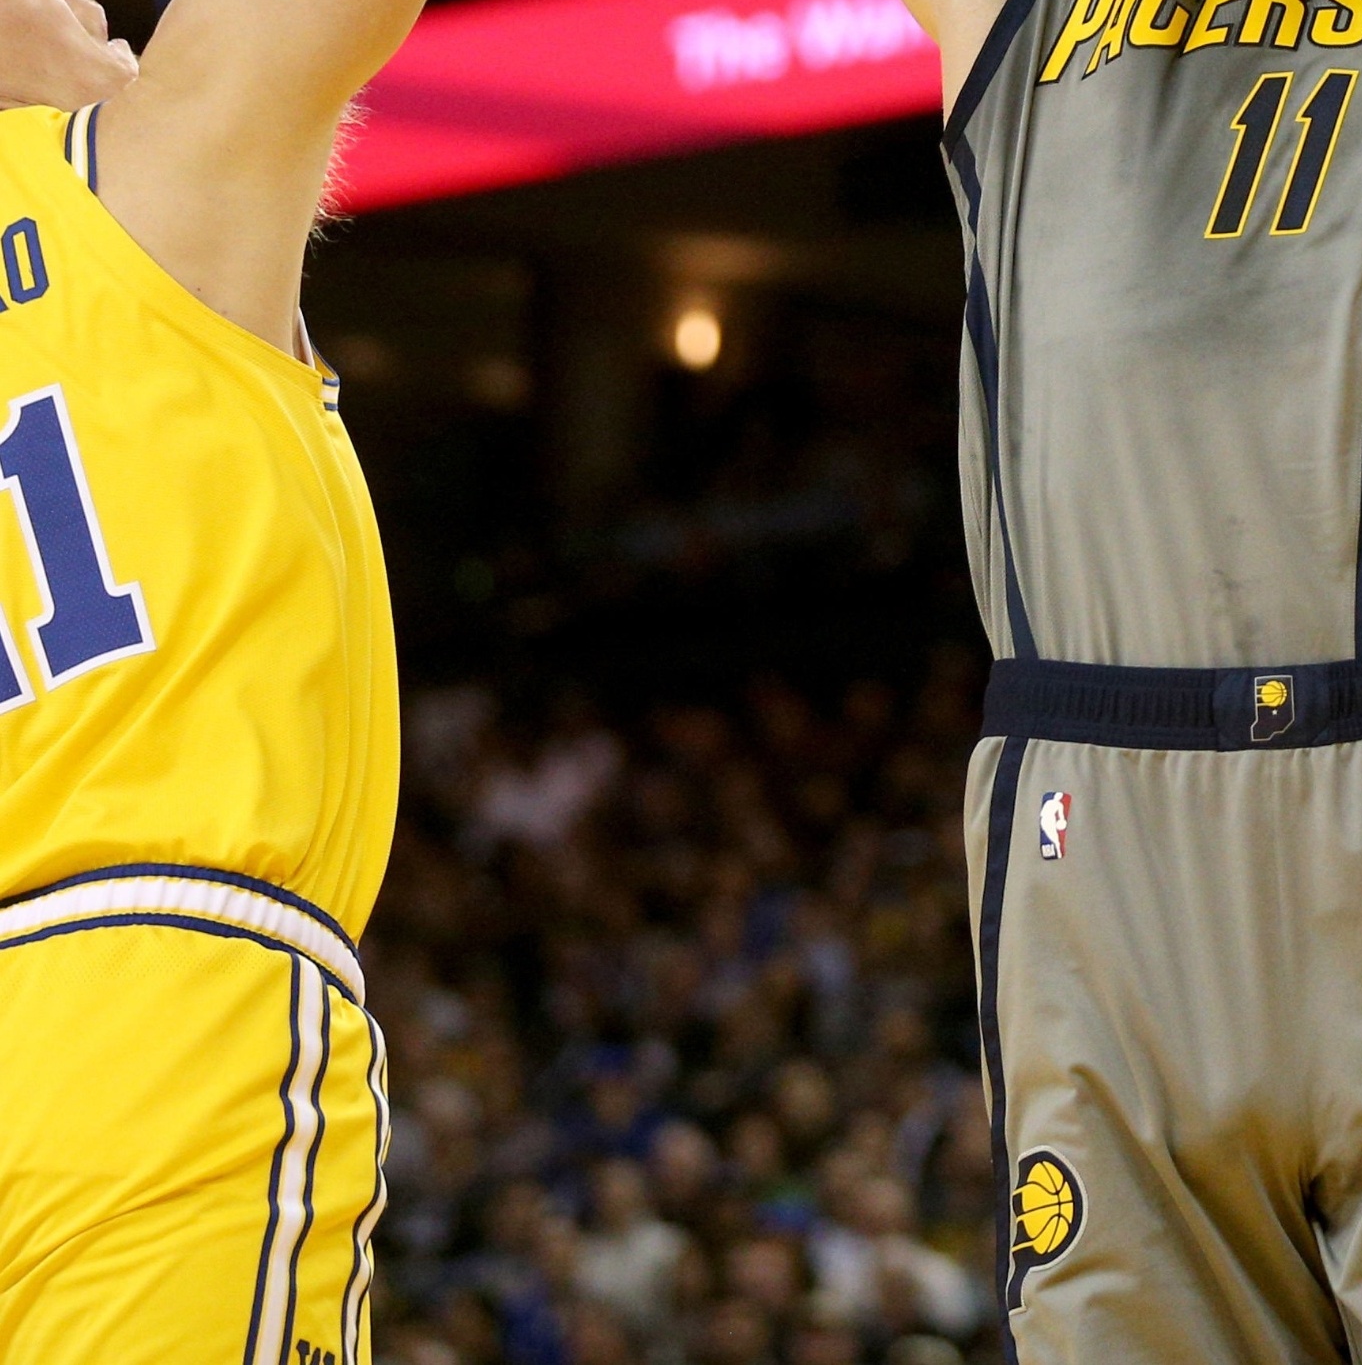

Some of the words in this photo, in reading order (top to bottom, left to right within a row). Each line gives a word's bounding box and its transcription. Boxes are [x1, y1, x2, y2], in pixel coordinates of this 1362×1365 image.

[1204, 68, 1360, 239] 11
[0, 217, 49, 312] O
[0, 382, 156, 715] 1
